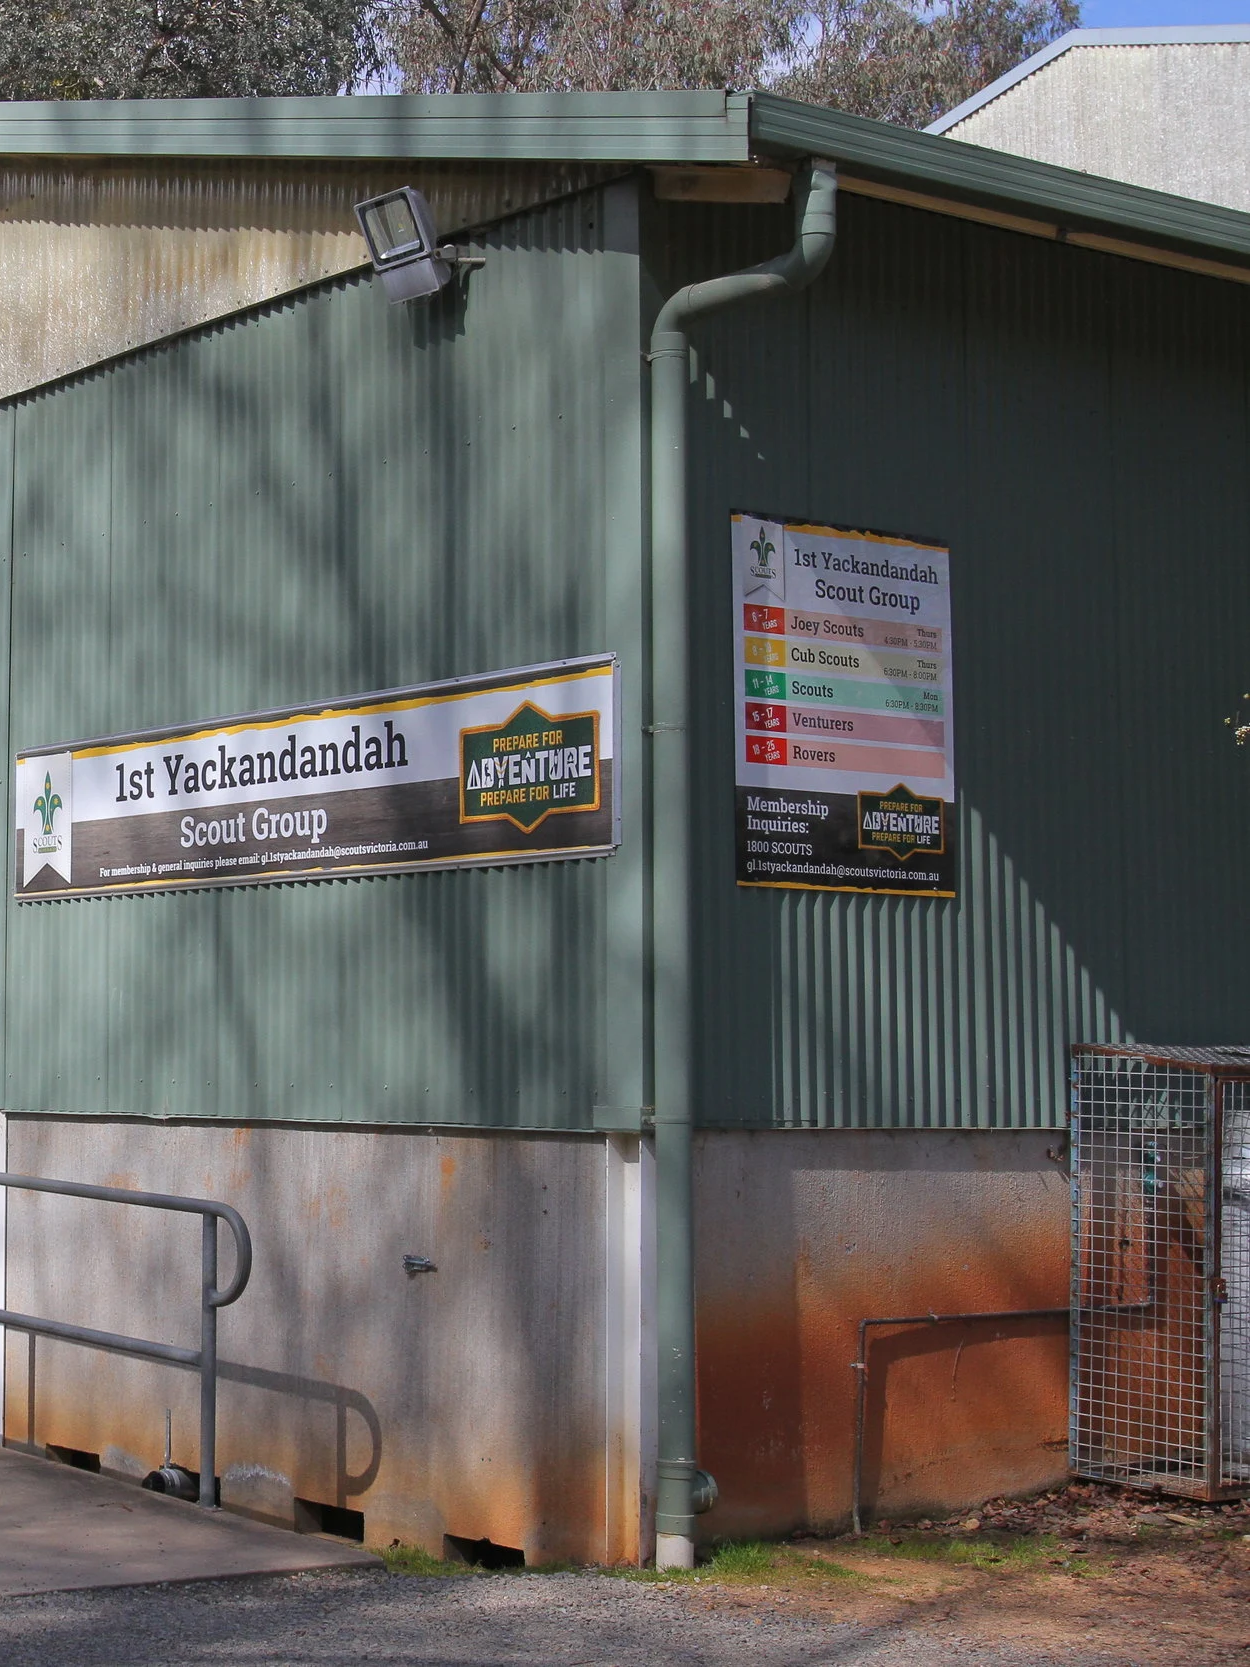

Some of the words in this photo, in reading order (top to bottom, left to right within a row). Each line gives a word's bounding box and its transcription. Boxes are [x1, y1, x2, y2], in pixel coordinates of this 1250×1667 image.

[794, 548, 817, 568] 1st
[821, 552, 939, 585] Yackandandah
[815, 579, 865, 604] Scout
[869, 586, 920, 615] Group
[763, 608, 768, 619] 7
[791, 616, 820, 636] Joey
[823, 619, 864, 638] Scouts
[917, 628, 937, 639] Thurs
[791, 647, 815, 664] Cub
[819, 651, 860, 668] Scouts
[917, 659, 937, 669] Thurs
[753, 678, 759, 689] 11
[765, 674, 774, 686] 14
[764, 685, 780, 696] YEARS
[792, 680, 834, 698] Scouts
[923, 690, 938, 701] Mon
[766, 707, 773, 718] 17
[792, 712, 854, 731] Venturers
[764, 718, 780, 728] YEARS
[493, 733, 540, 753] PREPARE
[542, 730, 563, 747] FOR
[115, 761, 155, 802] 1st
[163, 720, 409, 796] Yackandandah
[765, 750, 781, 761] YEARS
[793, 745, 836, 763] Rovers
[466, 744, 592, 790] ADVENTURE
[480, 788, 527, 807] PREPARE
[529, 785, 550, 802] FOR
[553, 782, 576, 799] LIFE
[747, 796, 829, 820] Membership
[879, 800, 908, 812] PREPARE
[910, 802, 923, 813] FOR
[180, 812, 246, 848] Scout
[252, 807, 328, 843] Group
[747, 815, 810, 835] Inquiries:
[863, 811, 940, 835] ADVENTURE
[33, 835, 63, 853] SCOUTS
[871, 832, 901, 843] PREPARE
[902, 834, 916, 844] FOR
[916, 835, 931, 845] LIFE
[747, 840, 769, 853] 1800
[771, 842, 813, 856] SCOUTS
[99, 867, 111, 877] For
[111, 863, 151, 877] membership
[152, 863, 157, 873] &
[157, 860, 183, 874] general
[183, 858, 214, 872] inquiries
[215, 856, 238, 869] please
[238, 853, 260, 865] email:
[746, 859, 940, 881] gl.1styackandandah@scoutsvictoria.com.au
